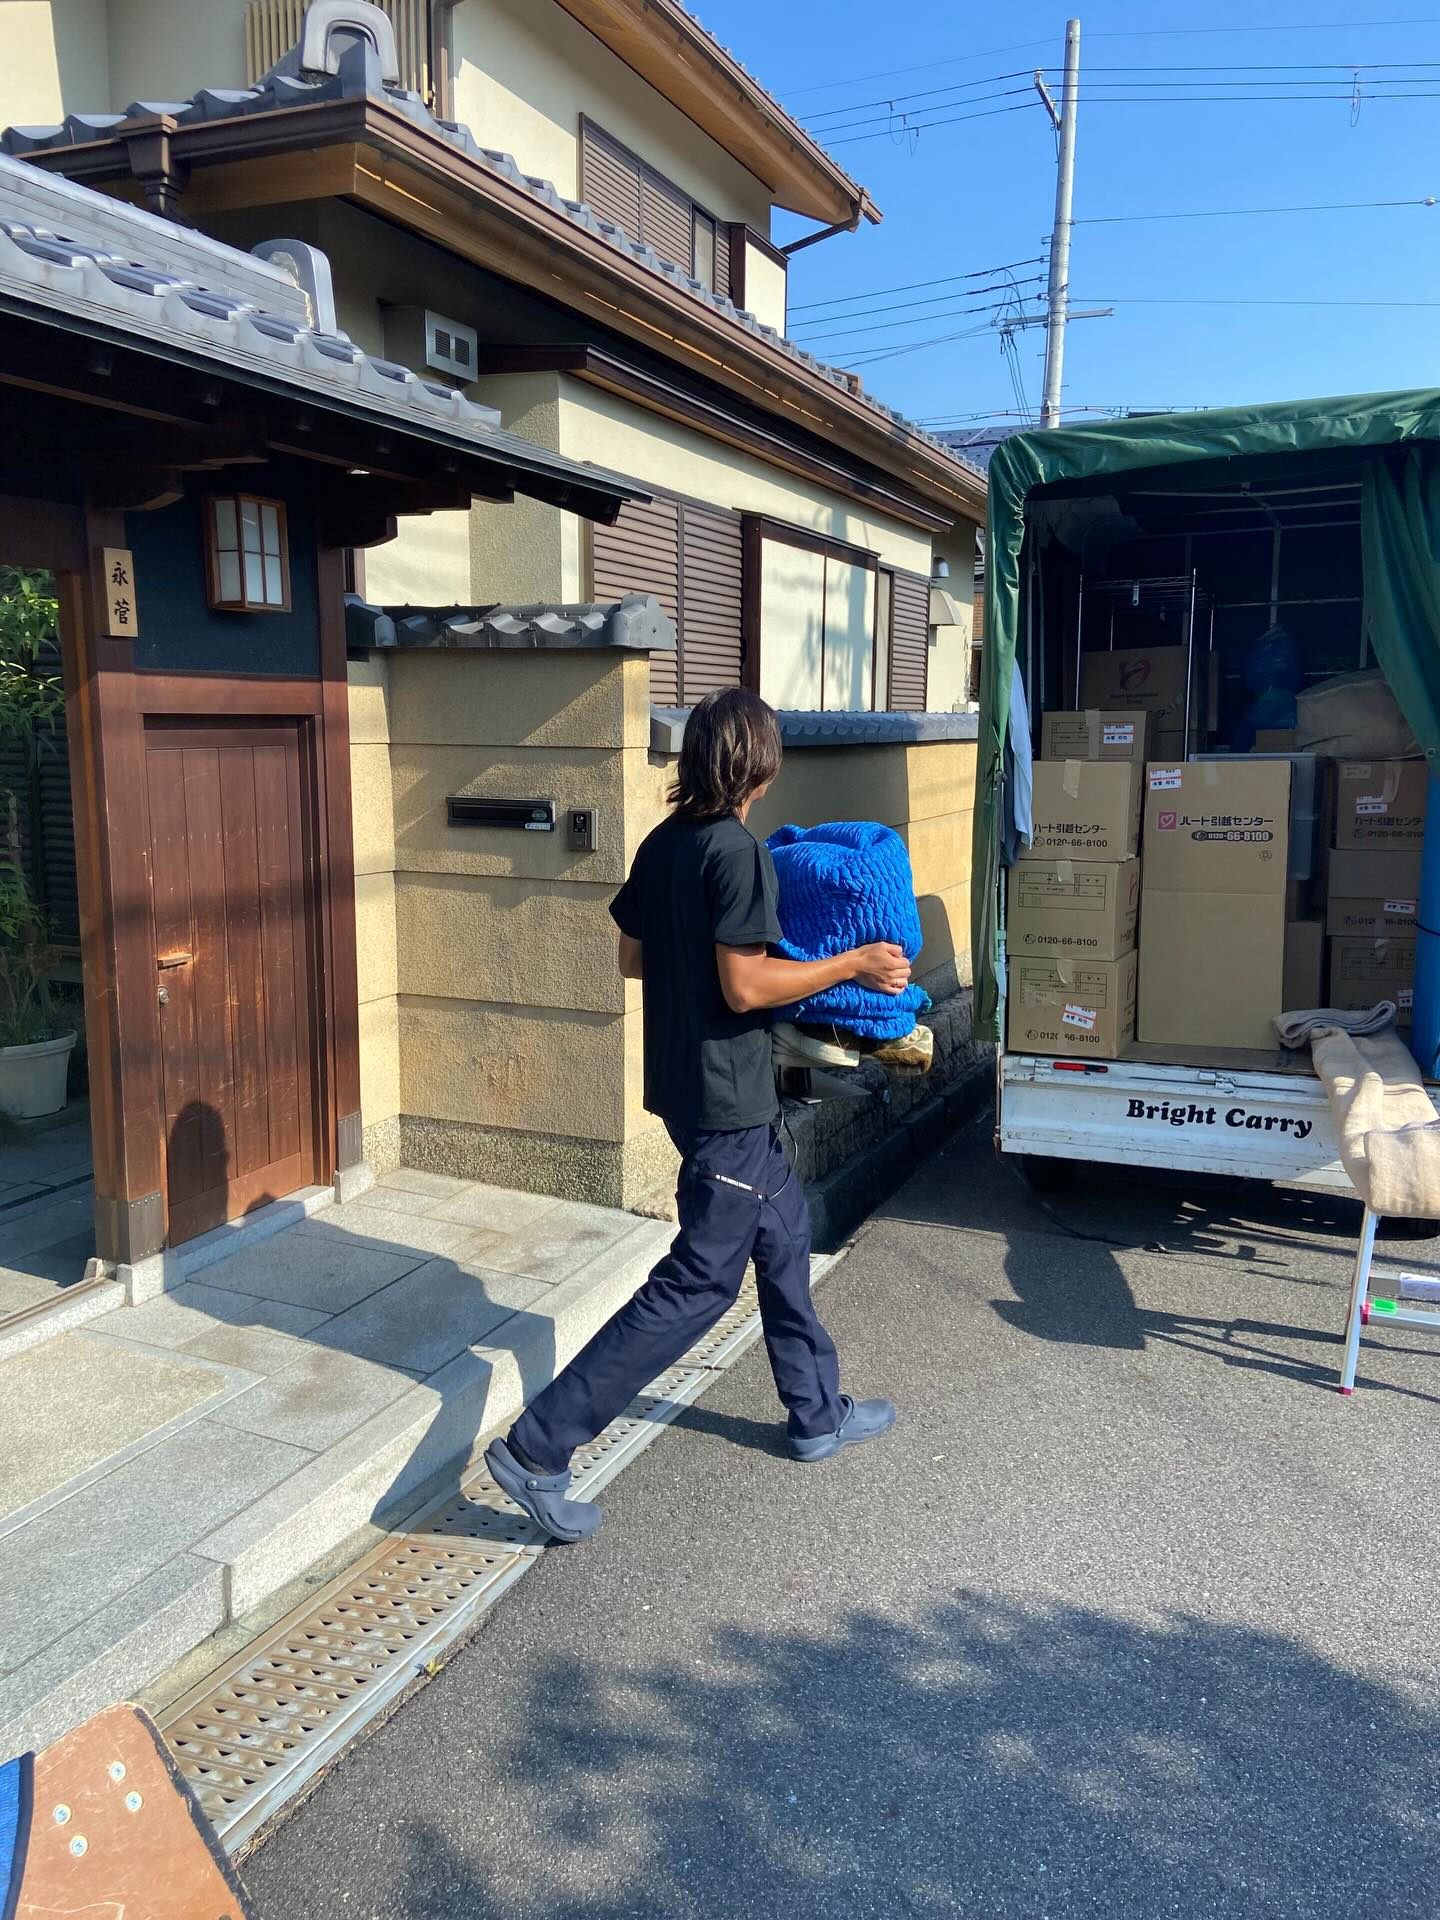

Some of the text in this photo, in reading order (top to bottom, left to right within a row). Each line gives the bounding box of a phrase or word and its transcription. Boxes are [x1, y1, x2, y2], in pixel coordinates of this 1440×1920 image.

[111, 561, 130, 625] 永菅
[1179, 815, 1274, 827] ハート引越センター
[1033, 823, 1108, 834] ハート引越センター
[1208, 830, 1270, 841] 0120-66-8100
[1037, 935, 1098, 947] 0120-66-8100
[1126, 1098, 1313, 1139] Bright Carry
